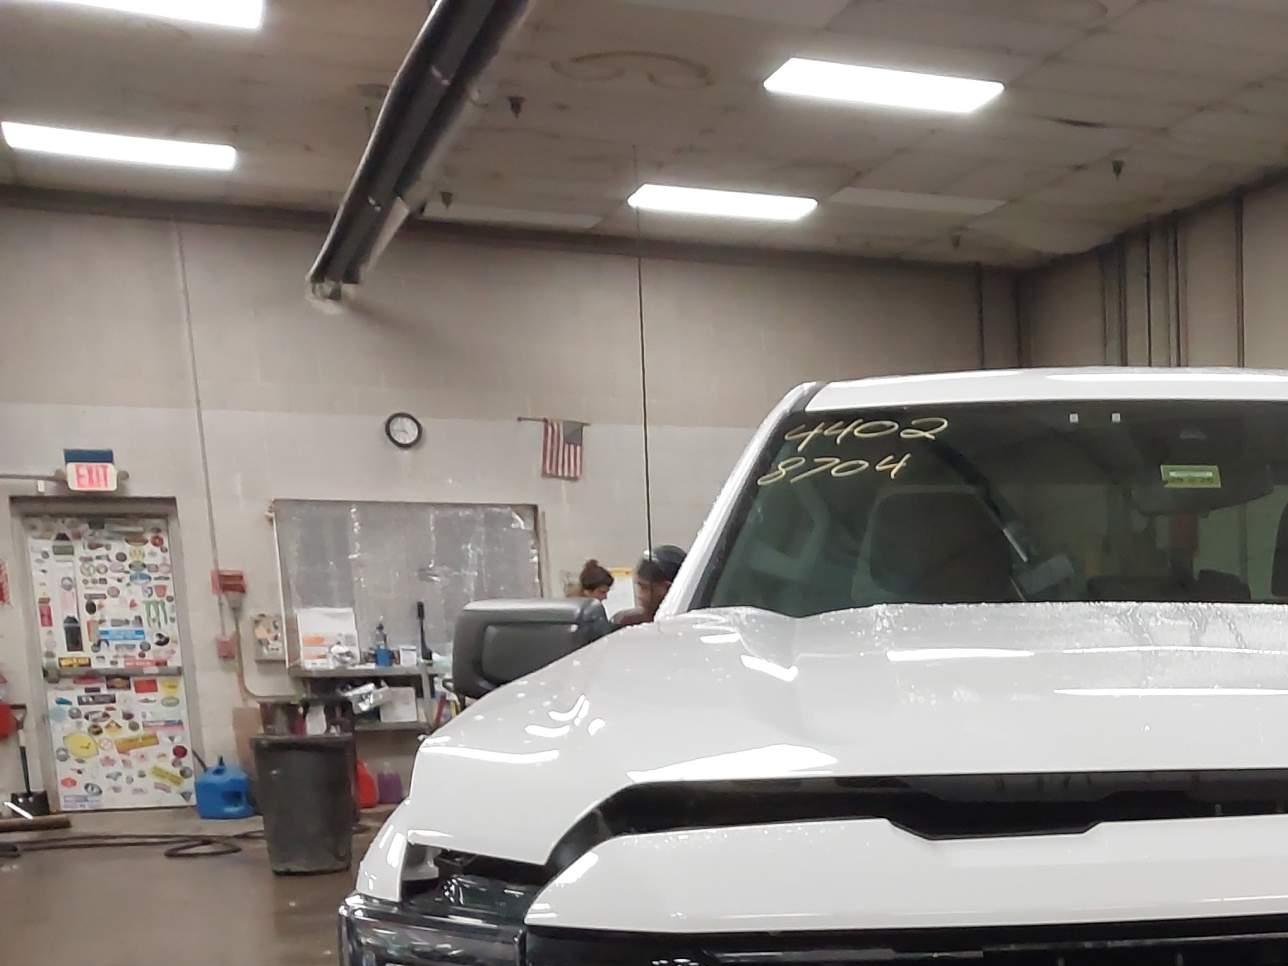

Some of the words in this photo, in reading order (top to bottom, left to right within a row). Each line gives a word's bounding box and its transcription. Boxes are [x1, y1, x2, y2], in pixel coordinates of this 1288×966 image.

[784, 417, 949, 453] 4402
[74, 463, 110, 489] EXIT
[757, 452, 912, 486] 8704
